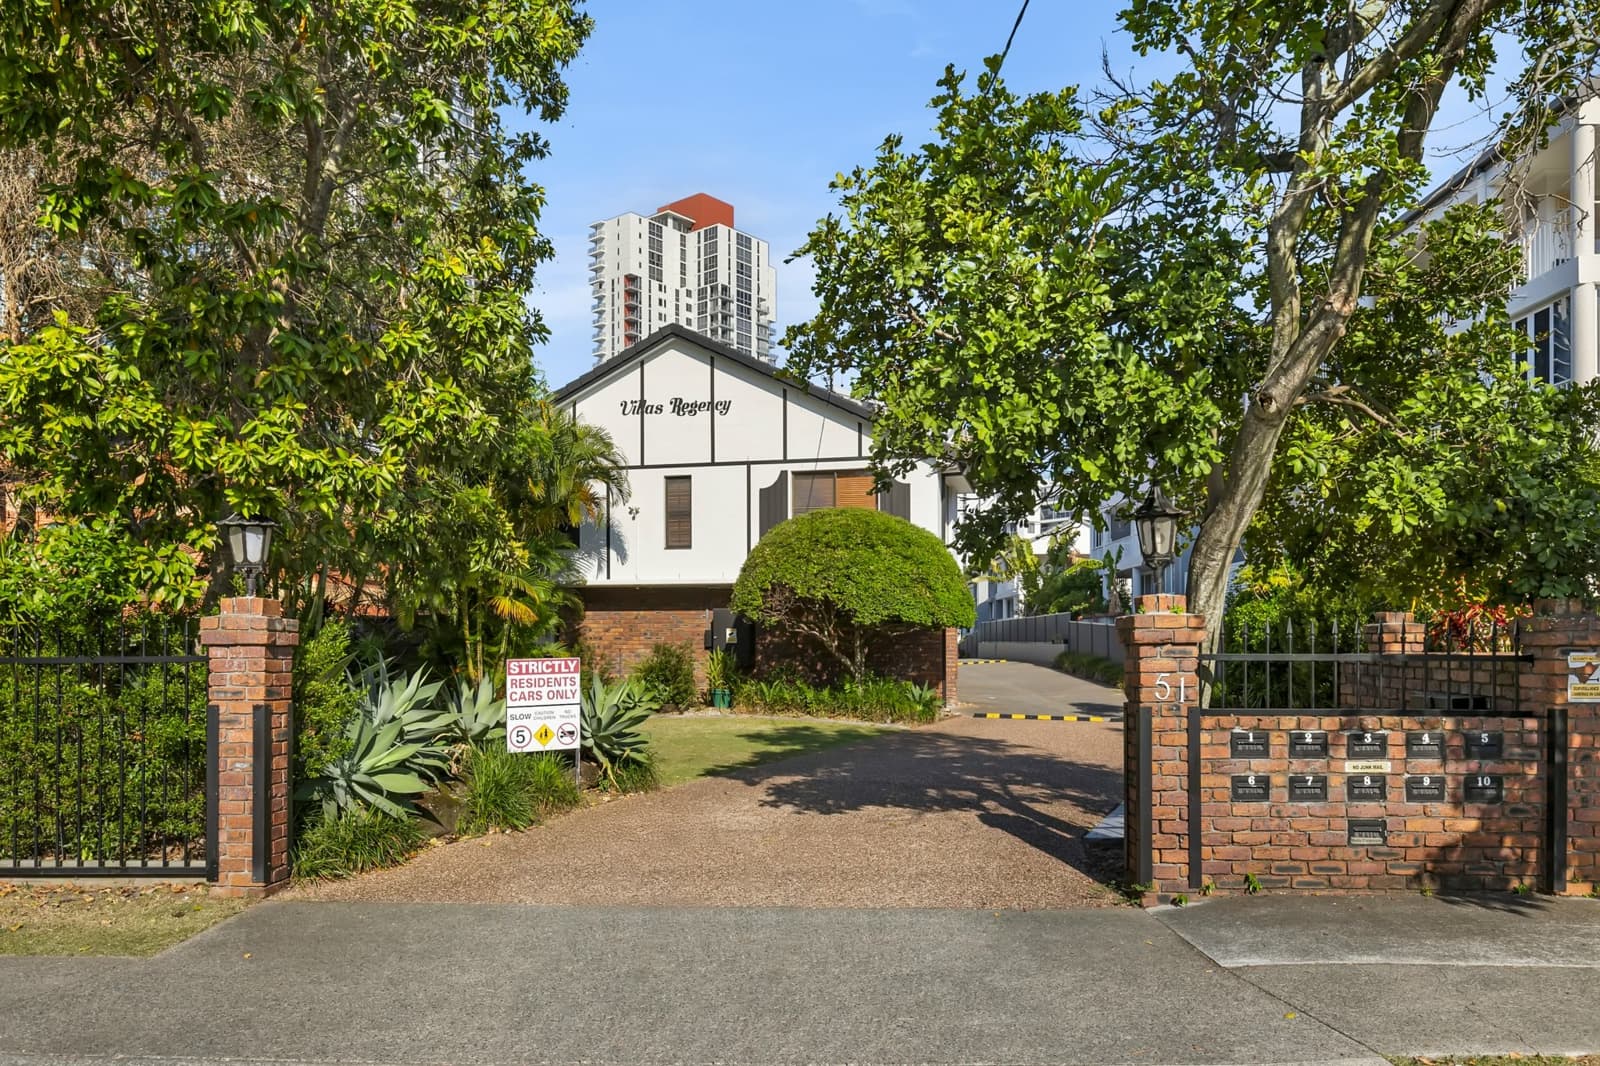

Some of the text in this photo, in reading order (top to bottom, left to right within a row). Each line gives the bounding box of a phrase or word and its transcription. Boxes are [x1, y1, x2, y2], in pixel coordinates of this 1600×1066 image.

[620, 397, 732, 416] Villas Regency
[510, 661, 577, 674] STRICTLY
[510, 677, 577, 689] RESIDENTS
[1155, 673, 1185, 703] 51
[510, 689, 577, 702] CARS ONLY
[510, 713, 532, 721] SLOW
[516, 730, 526, 744] 5
[1247, 732, 1254, 742] 1
[1305, 732, 1313, 743] 2
[1364, 733, 1372, 743] 3
[1422, 733, 1430, 744] 4
[1481, 733, 1489, 743] 5
[1248, 775, 1255, 785] 6
[1305, 776, 1313, 786] 7
[1363, 775, 1371, 786] 8
[1423, 776, 1431, 786] 9
[1477, 776, 1491, 787] 10
